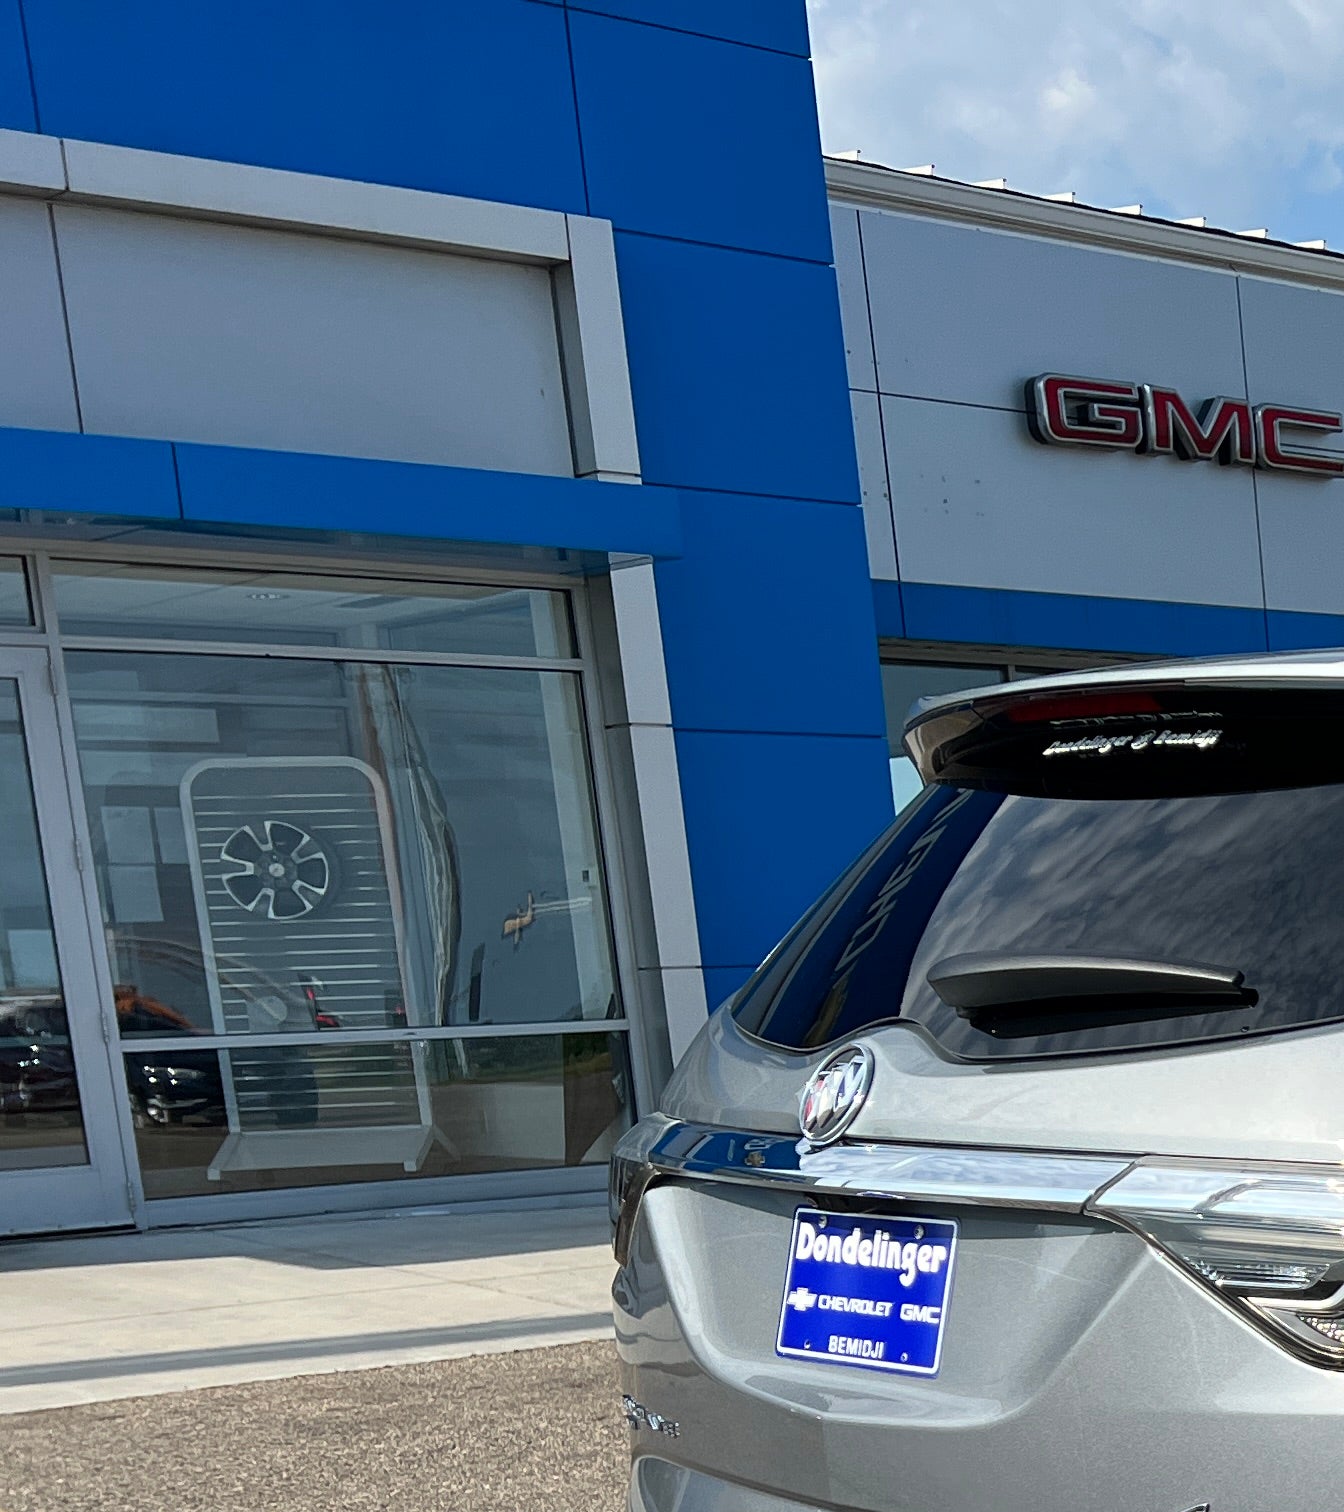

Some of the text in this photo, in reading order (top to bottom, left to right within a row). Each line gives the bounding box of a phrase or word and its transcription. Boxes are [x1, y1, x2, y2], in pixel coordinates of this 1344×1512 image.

[796, 1222, 947, 1287] Dondelinger
[818, 1294, 942, 1324] CHEVROLET GMC
[827, 1335, 885, 1359] BEMIDJI
